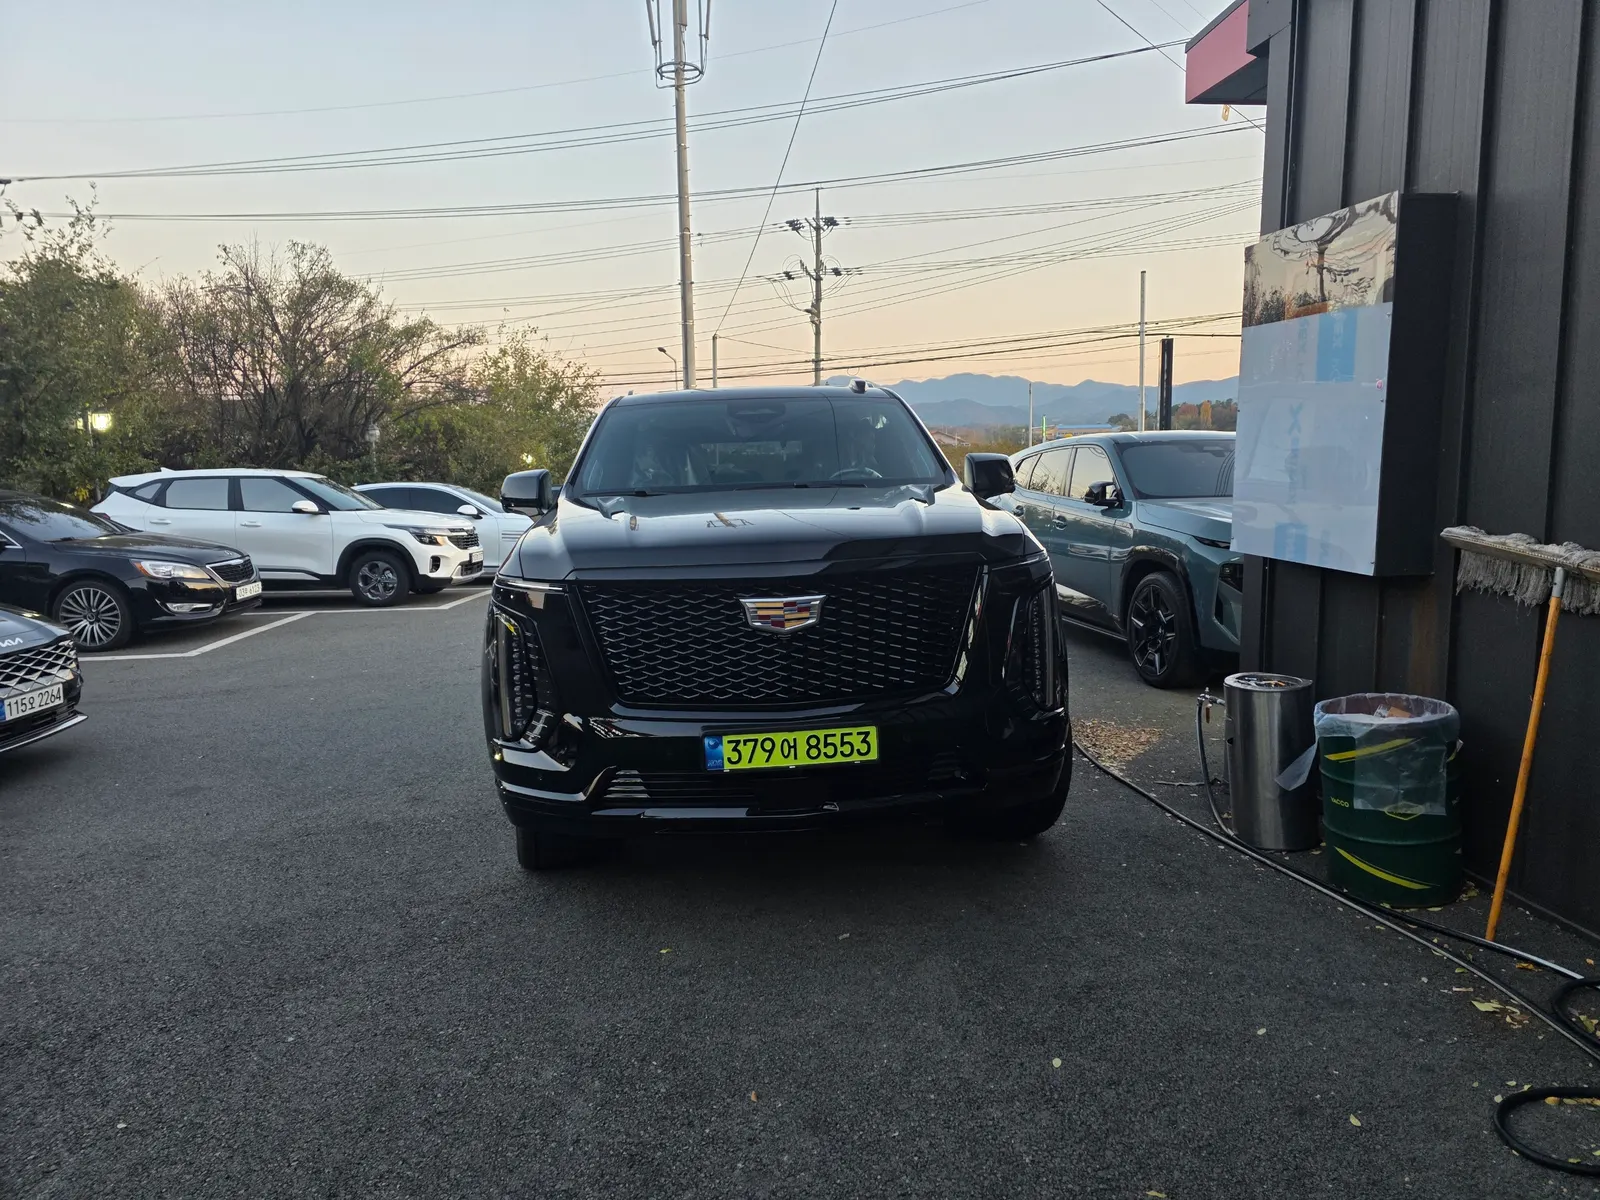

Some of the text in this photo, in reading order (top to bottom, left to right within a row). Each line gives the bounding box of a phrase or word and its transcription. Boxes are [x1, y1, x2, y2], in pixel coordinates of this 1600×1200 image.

[6, 686, 62, 717] 115오 2264
[726, 730, 872, 766] 379어 8553
